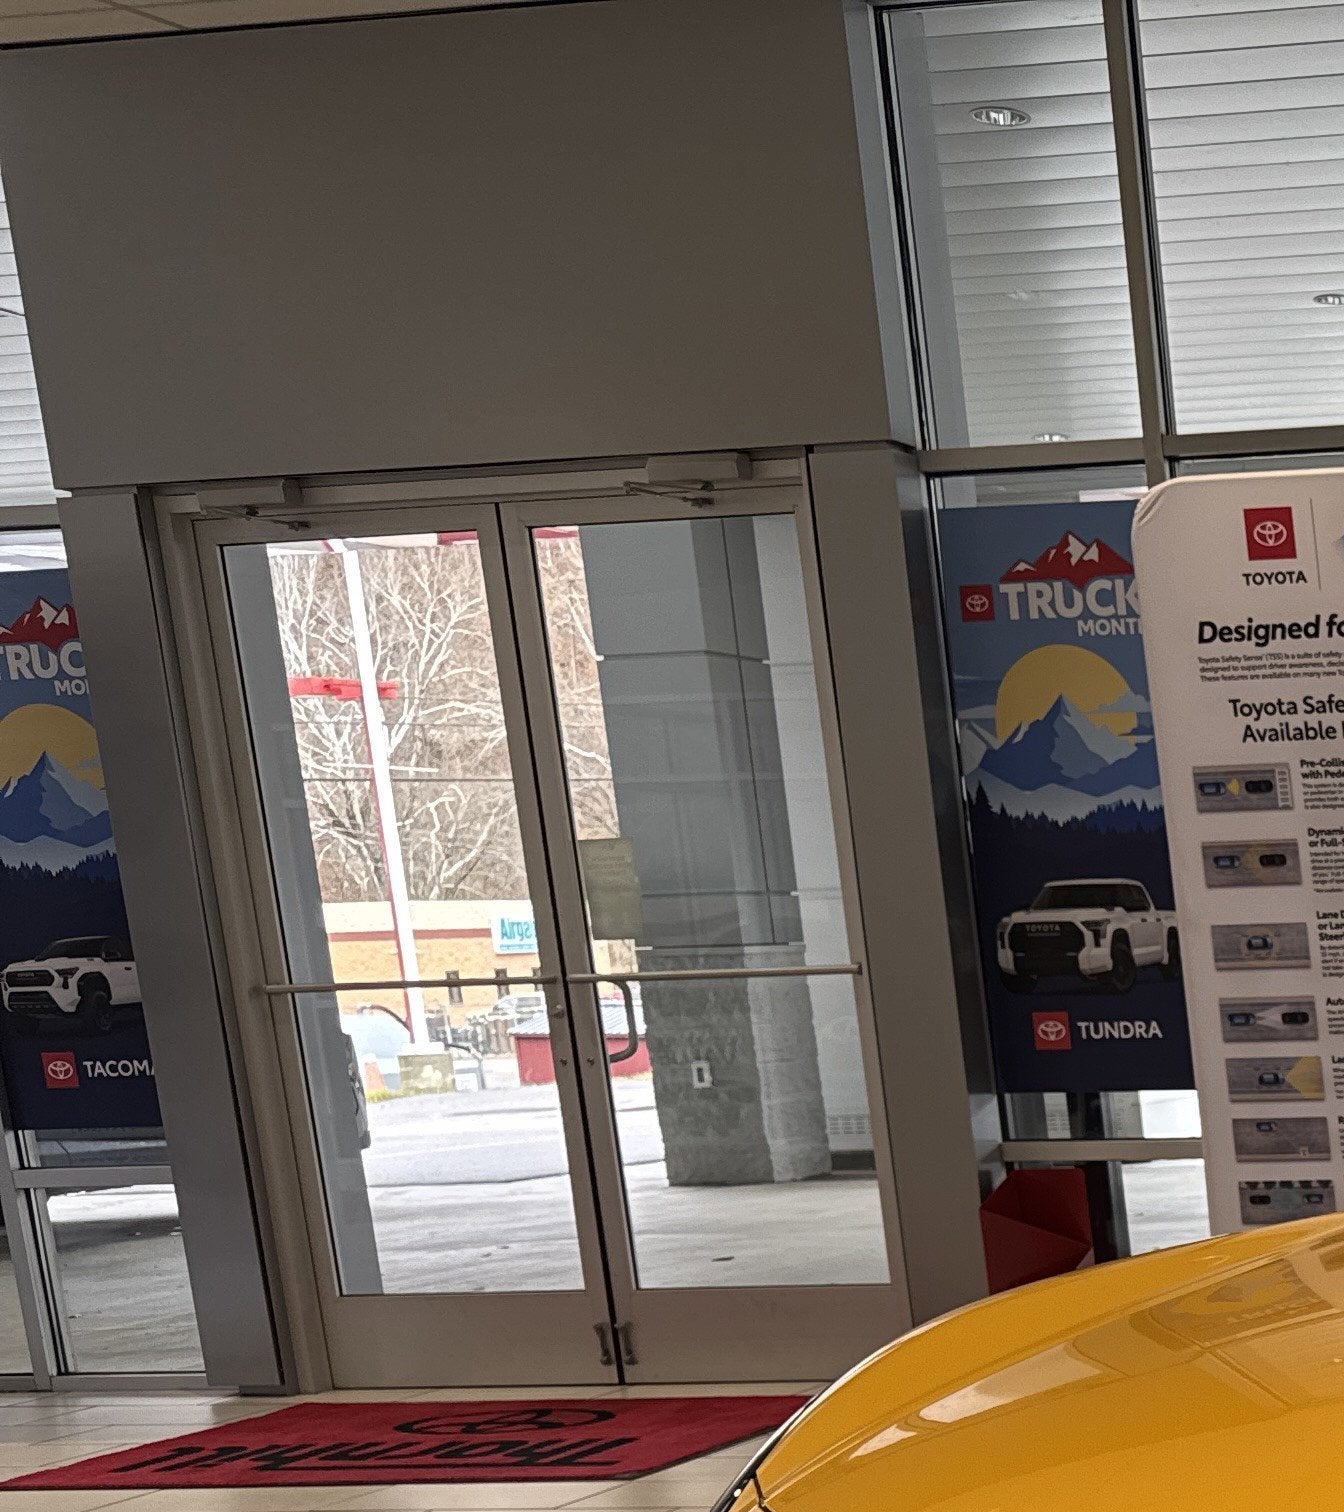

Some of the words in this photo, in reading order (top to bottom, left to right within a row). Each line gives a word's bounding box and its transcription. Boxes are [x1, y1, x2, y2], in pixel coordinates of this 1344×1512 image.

[1242, 571, 1308, 586] TOYOTA
[999, 579, 1141, 621] TRUCK
[1077, 617, 1143, 637] MONT
[1198, 614, 1321, 647] Designed
[54, 678, 90, 697] MO
[1229, 698, 1298, 721] Toyota
[1242, 720, 1336, 742] Available
[1301, 770, 1322, 778] with
[1308, 837, 1318, 847] or
[1316, 911, 1338, 919] Lane
[1077, 1020, 1163, 1040] TUNDRA
[83, 1059, 154, 1077] TACOM
[108, 1438, 637, 1474] Thornhill
